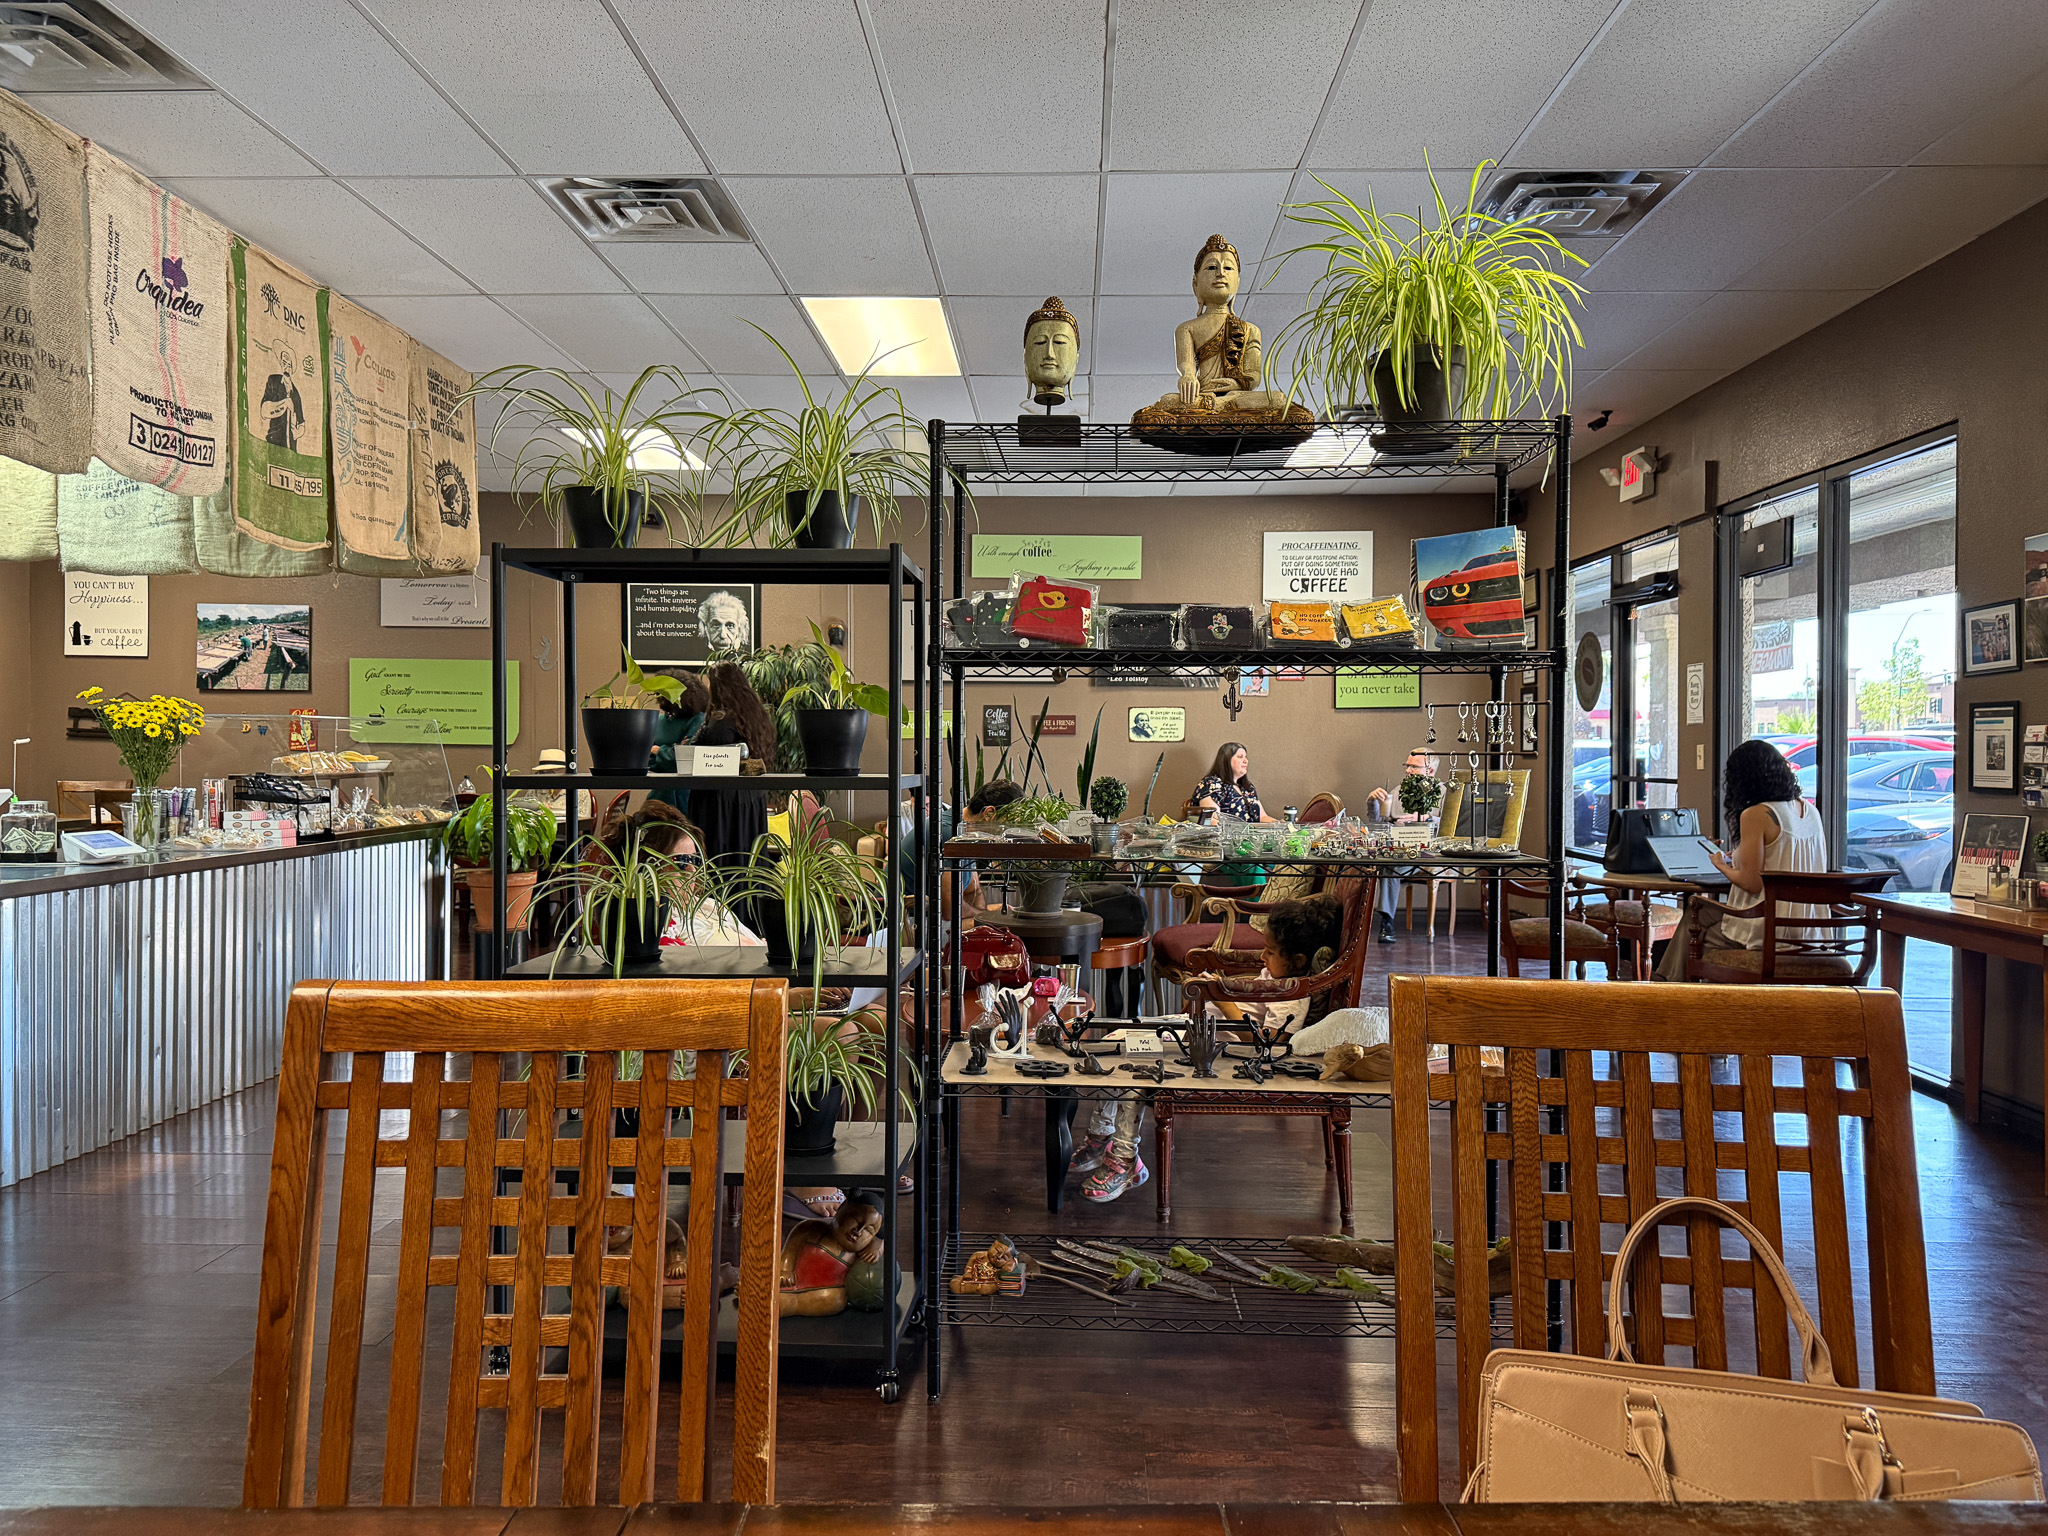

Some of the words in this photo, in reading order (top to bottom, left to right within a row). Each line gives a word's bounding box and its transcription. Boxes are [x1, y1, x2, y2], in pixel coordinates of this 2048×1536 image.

[284, 306, 306, 330] DNC
[130, 386, 174, 409] PRODUCTO
[183, 408, 213, 422] COLOMBIA
[155, 407, 167, 417] 70
[136, 422, 147, 444] 3
[185, 442, 213, 461] 00127
[1281, 541, 1358, 550] PROCAFFEINATING
[976, 544, 997, 557] With
[998, 547, 1023, 562] enough
[1058, 559, 1102, 576] Anything
[1110, 561, 1138, 576] possible
[1281, 568, 1306, 576] UNTIL
[1308, 568, 1338, 576] YOU'VE
[1340, 568, 1358, 576] HAD
[73, 581, 91, 589] YOU
[92, 581, 116, 589] CAN'T
[118, 581, 135, 590] BUY
[399, 579, 449, 588] Tomorrow
[660, 588, 678, 597] things
[422, 595, 457, 612] Today
[670, 605, 698, 613] stupidity.
[451, 616, 489, 625] Present
[100, 635, 143, 650] coffee
[364, 667, 386, 682] God
[380, 684, 415, 697] Serenity
[1340, 685, 1358, 697] you
[1362, 686, 1390, 694] never
[1394, 683, 1415, 694] take
[985, 708, 1009, 720] Coffee
